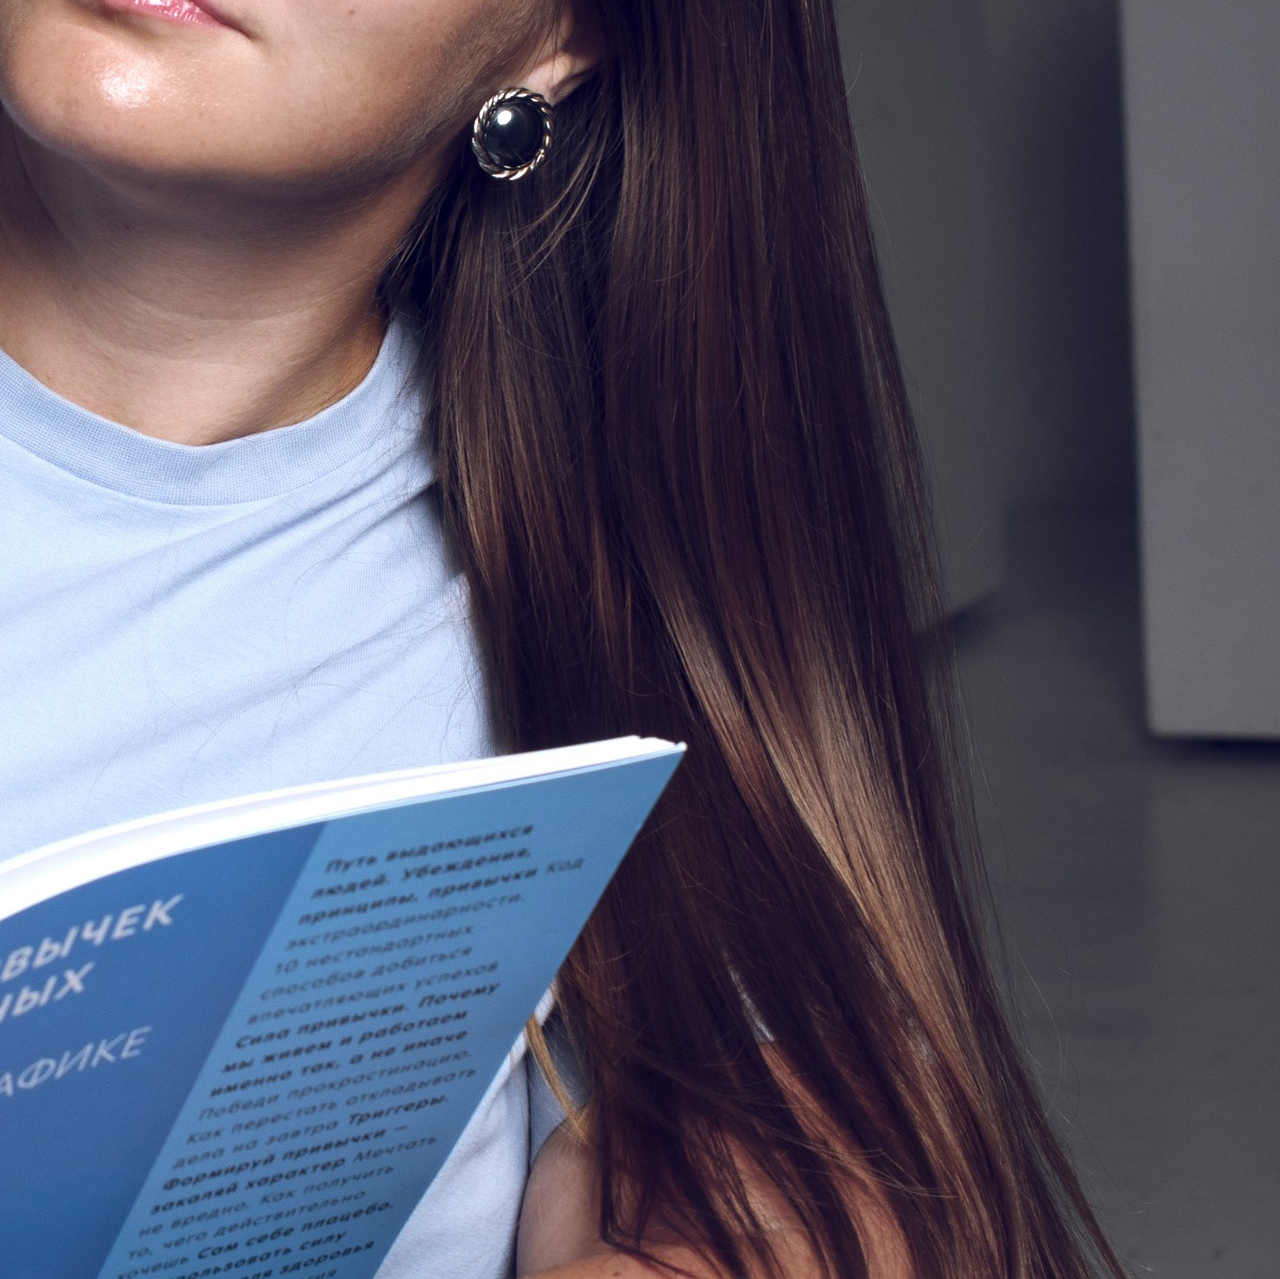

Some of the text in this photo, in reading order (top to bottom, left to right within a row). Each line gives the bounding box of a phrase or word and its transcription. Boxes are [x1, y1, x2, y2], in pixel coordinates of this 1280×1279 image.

[324, 823, 534, 873] Путь выдающихся
[427, 867, 538, 898] привычки
[221, 1058, 254, 1073] мы
[260, 1039, 333, 1064] живем
[356, 1009, 468, 1045] работаем
[234, 1027, 291, 1050] Сила
[417, 982, 499, 1008] Почему
[209, 1069, 293, 1098] именно
[369, 1045, 396, 1060] не
[402, 1029, 468, 1053] иначе
[149, 1157, 346, 1215] закаляй характер
[161, 1128, 386, 1191] Формируй привычки
[196, 1240, 239, 1260] Сам
[244, 1226, 295, 1247] себе
[278, 1240, 375, 1275] здоровья
[298, 1230, 346, 1251] силу
